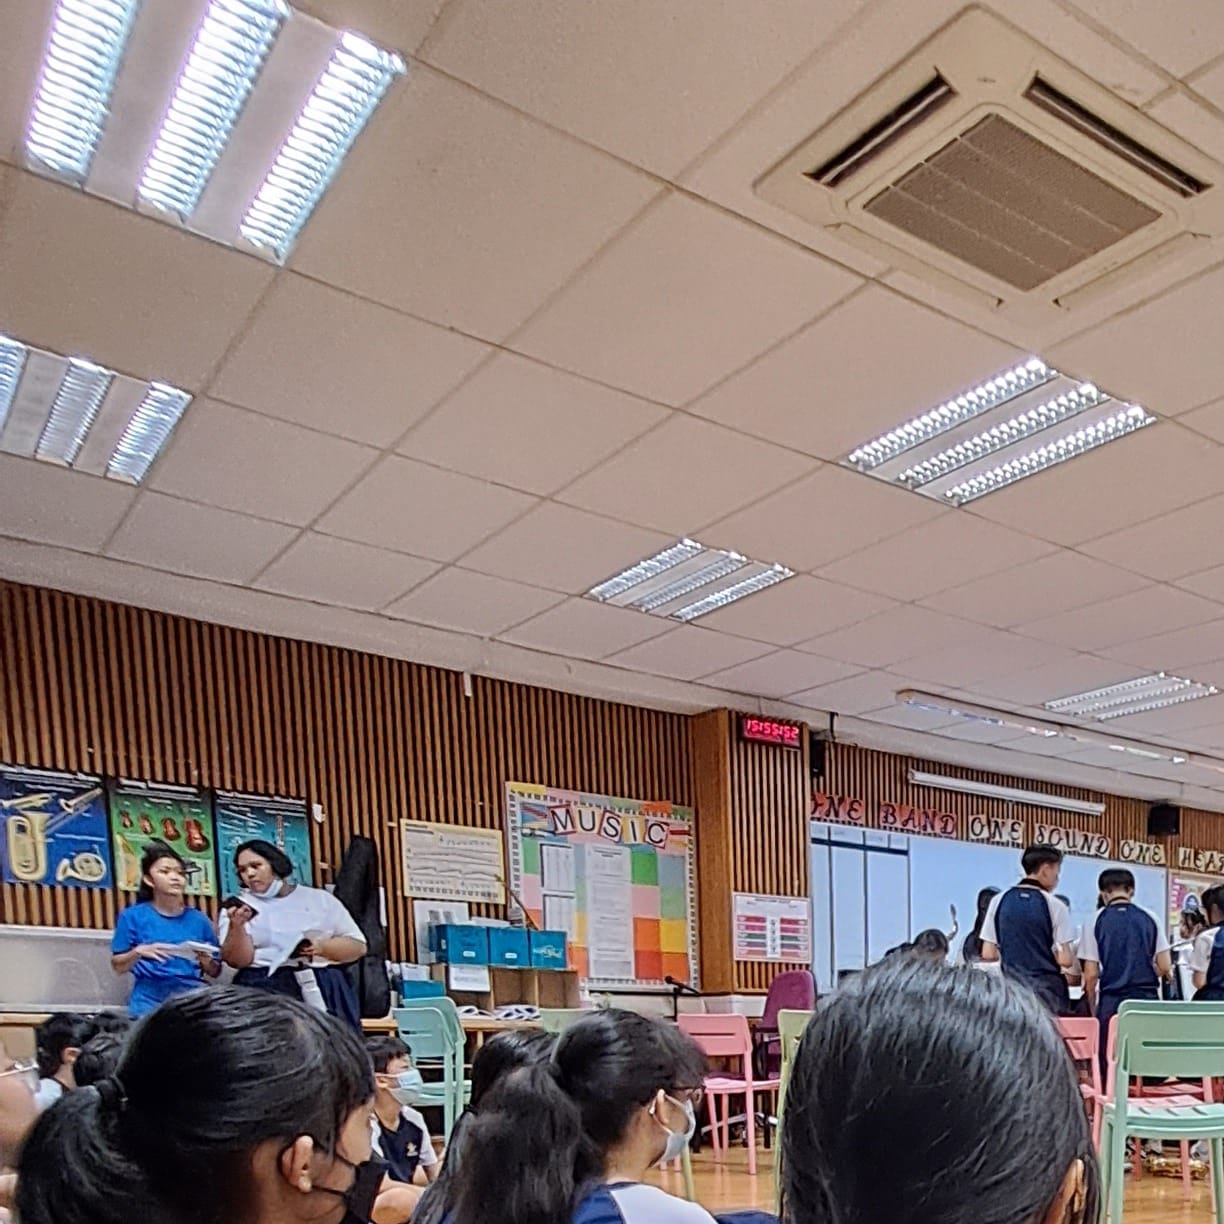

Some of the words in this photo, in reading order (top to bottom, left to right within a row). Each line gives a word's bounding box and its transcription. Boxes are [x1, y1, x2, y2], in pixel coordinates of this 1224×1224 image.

[551, 807, 667, 845] MUSIC
[882, 801, 956, 835] BAND
[970, 815, 1023, 842] ONE
[1035, 824, 1110, 856] SOUND
[1119, 841, 1162, 864] ONE
